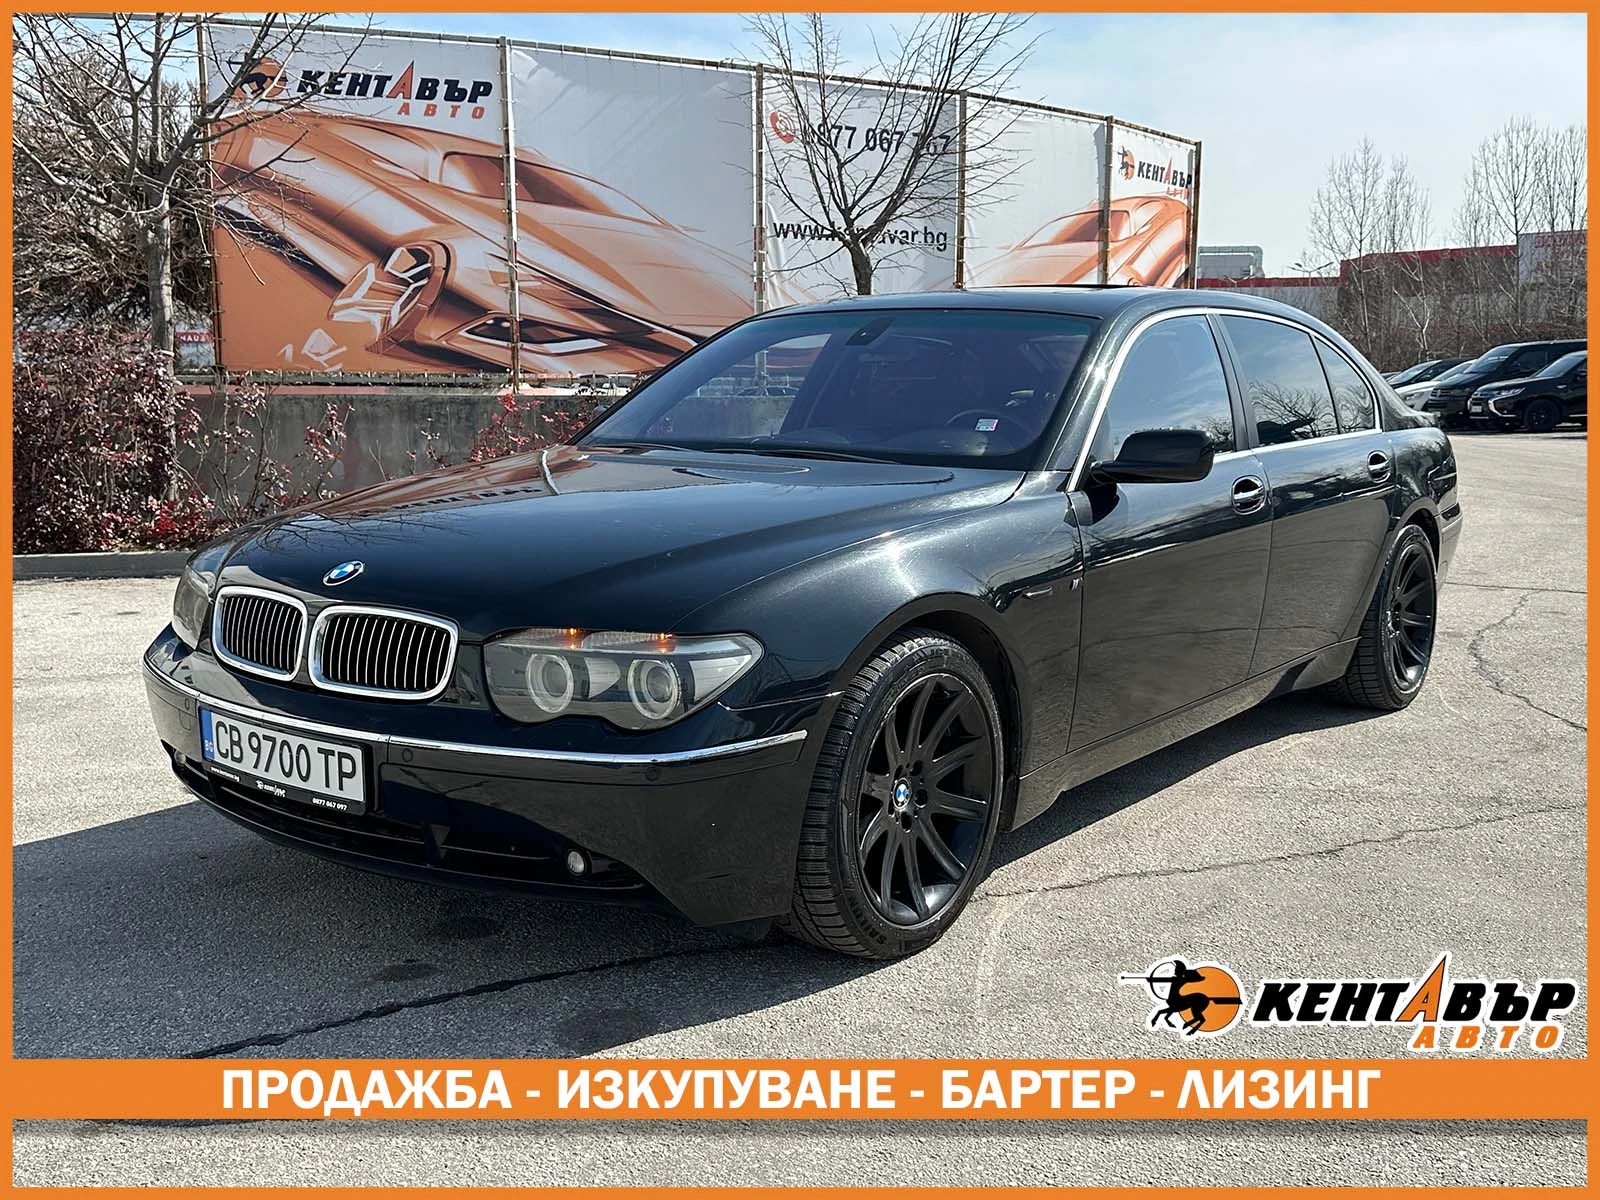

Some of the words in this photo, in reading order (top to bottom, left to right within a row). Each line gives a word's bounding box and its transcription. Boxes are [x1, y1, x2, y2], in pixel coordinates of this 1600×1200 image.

[296, 60, 493, 103] КЕНТАВЪР
[397, 102, 485, 119] АВТО
[865, 128, 904, 152] 067
[1137, 156, 1192, 188] КЕНТАВЪР
[215, 720, 244, 764] CB
[247, 731, 312, 783] 9700
[317, 746, 357, 791] TP
